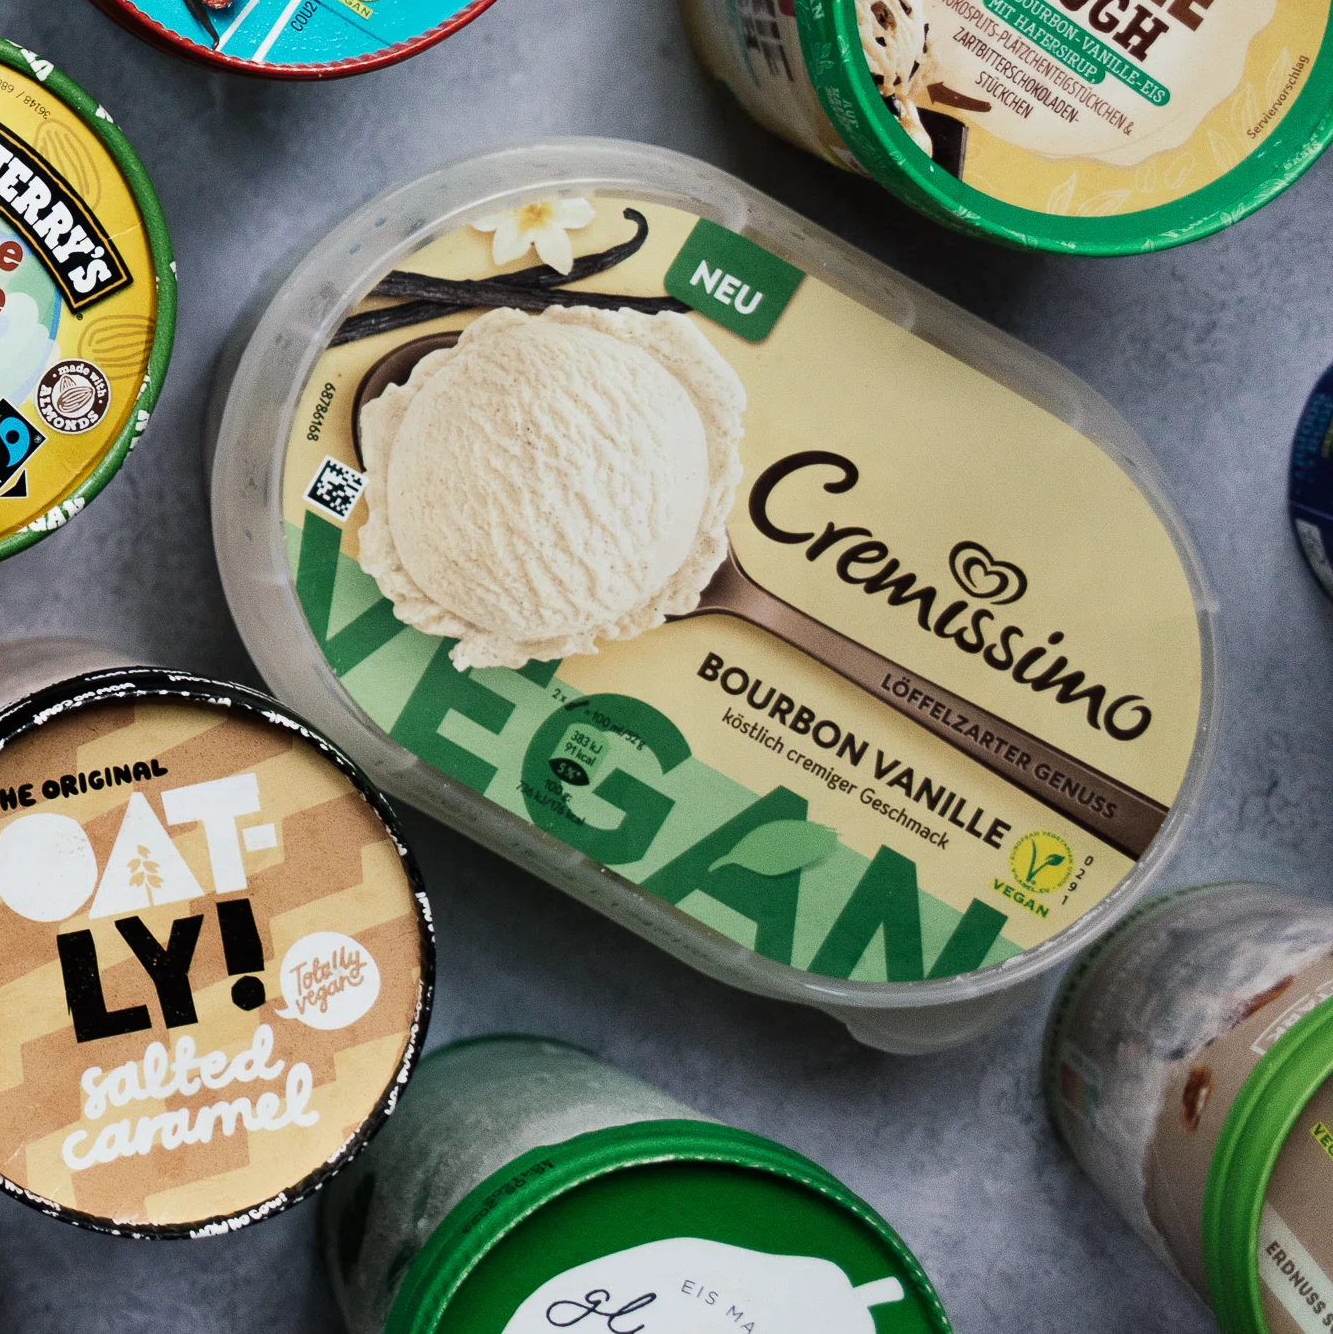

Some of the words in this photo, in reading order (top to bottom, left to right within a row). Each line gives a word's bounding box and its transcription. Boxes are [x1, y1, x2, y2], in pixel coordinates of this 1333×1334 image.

[974, 71, 1035, 120] STÜCKCHEN
[1245, 54, 1311, 140] Serviervorschlag
[687, 259, 767, 318] NEU
[747, 449, 1155, 745] Cremissimo
[46, 759, 169, 801] ORIGINAL
[695, 651, 871, 776] BOURBON
[871, 755, 1014, 851] VANILLE
[721, 704, 793, 761] köstlich
[784, 740, 866, 802] cremiger
[856, 781, 952, 852] Geschmack
[879, 670, 1033, 776] LÖFFELZARTER
[1030, 758, 1121, 821] GENUSS
[56, 897, 266, 1044] LY!
[61, 1062, 321, 1172] caramel
[80, 1024, 285, 1120] salted
[680, 1278, 720, 1306] EIS
[1264, 1239, 1326, 1316] ERDNUSS
